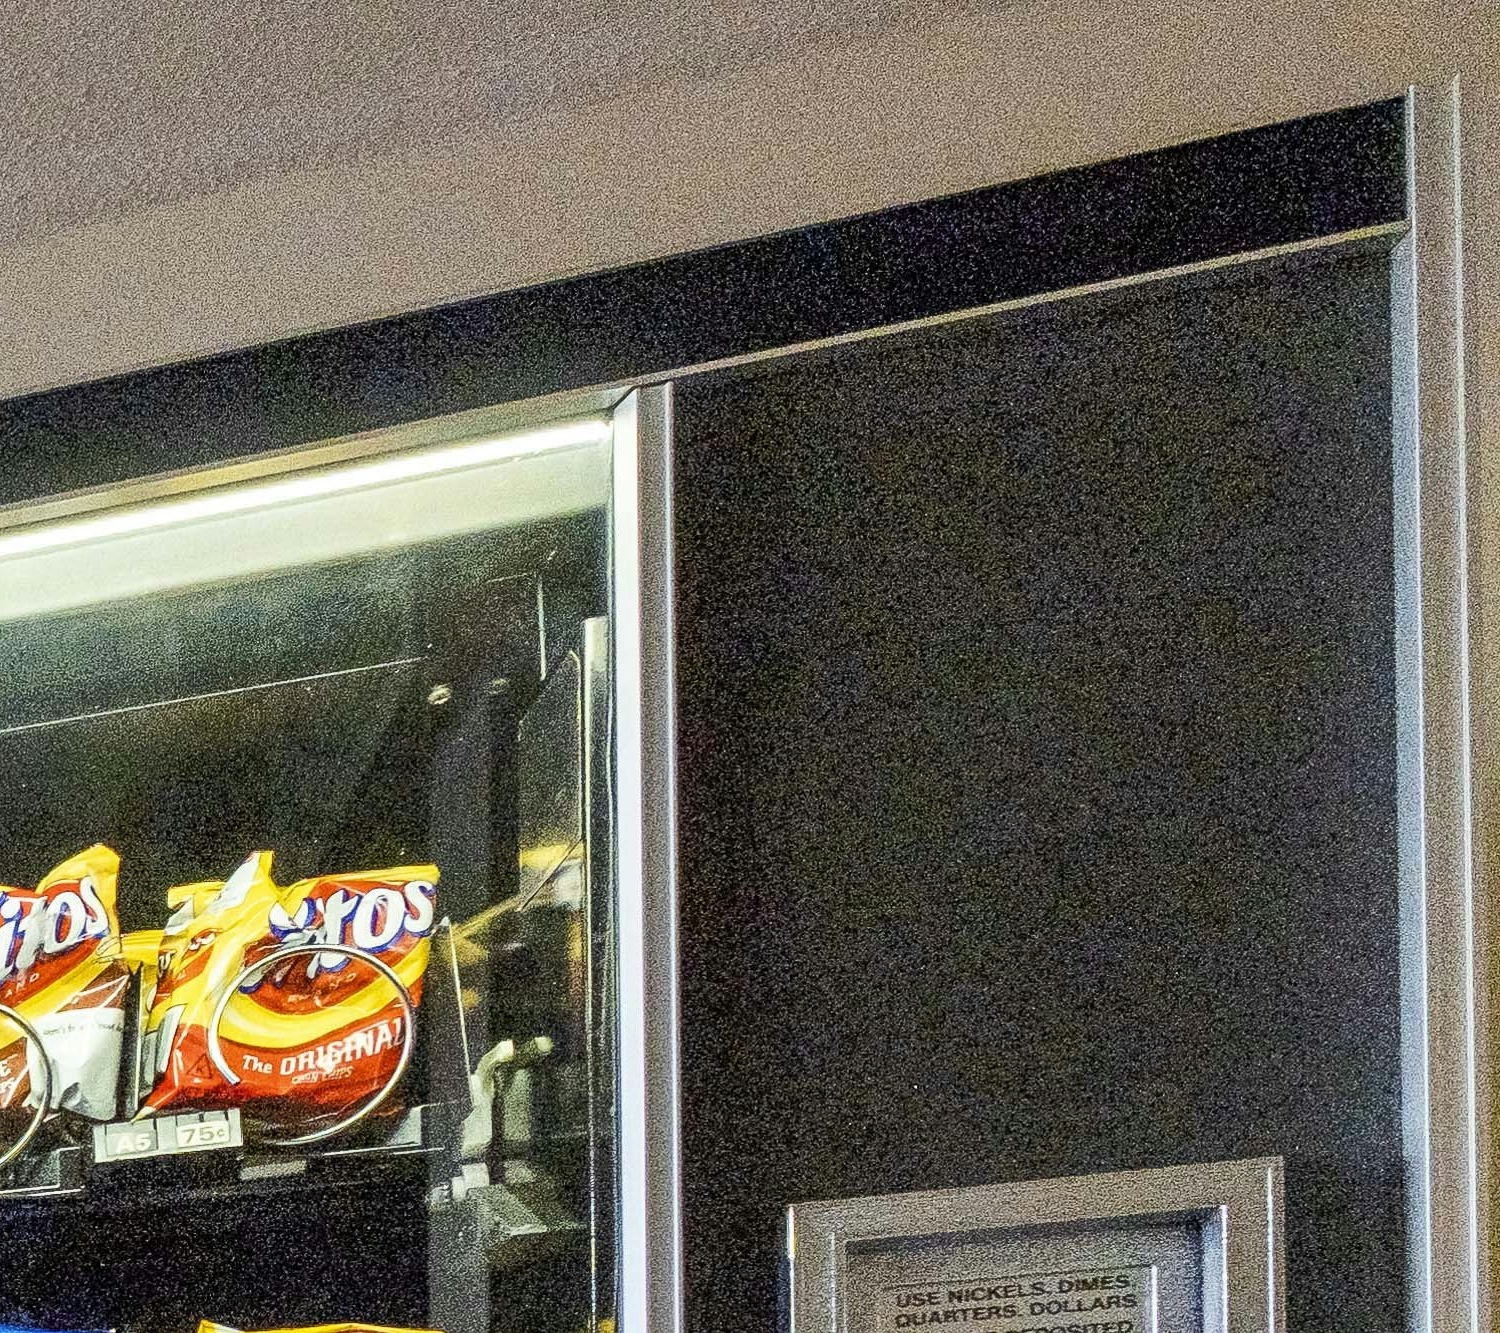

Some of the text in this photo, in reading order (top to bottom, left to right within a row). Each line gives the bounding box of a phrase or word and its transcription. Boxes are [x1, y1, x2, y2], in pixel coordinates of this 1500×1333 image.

[242, 1015, 405, 1076] The ORIGINAL
[116, 1134, 152, 1152] A5
[1030, 1294, 1138, 1316] DOLLARS
